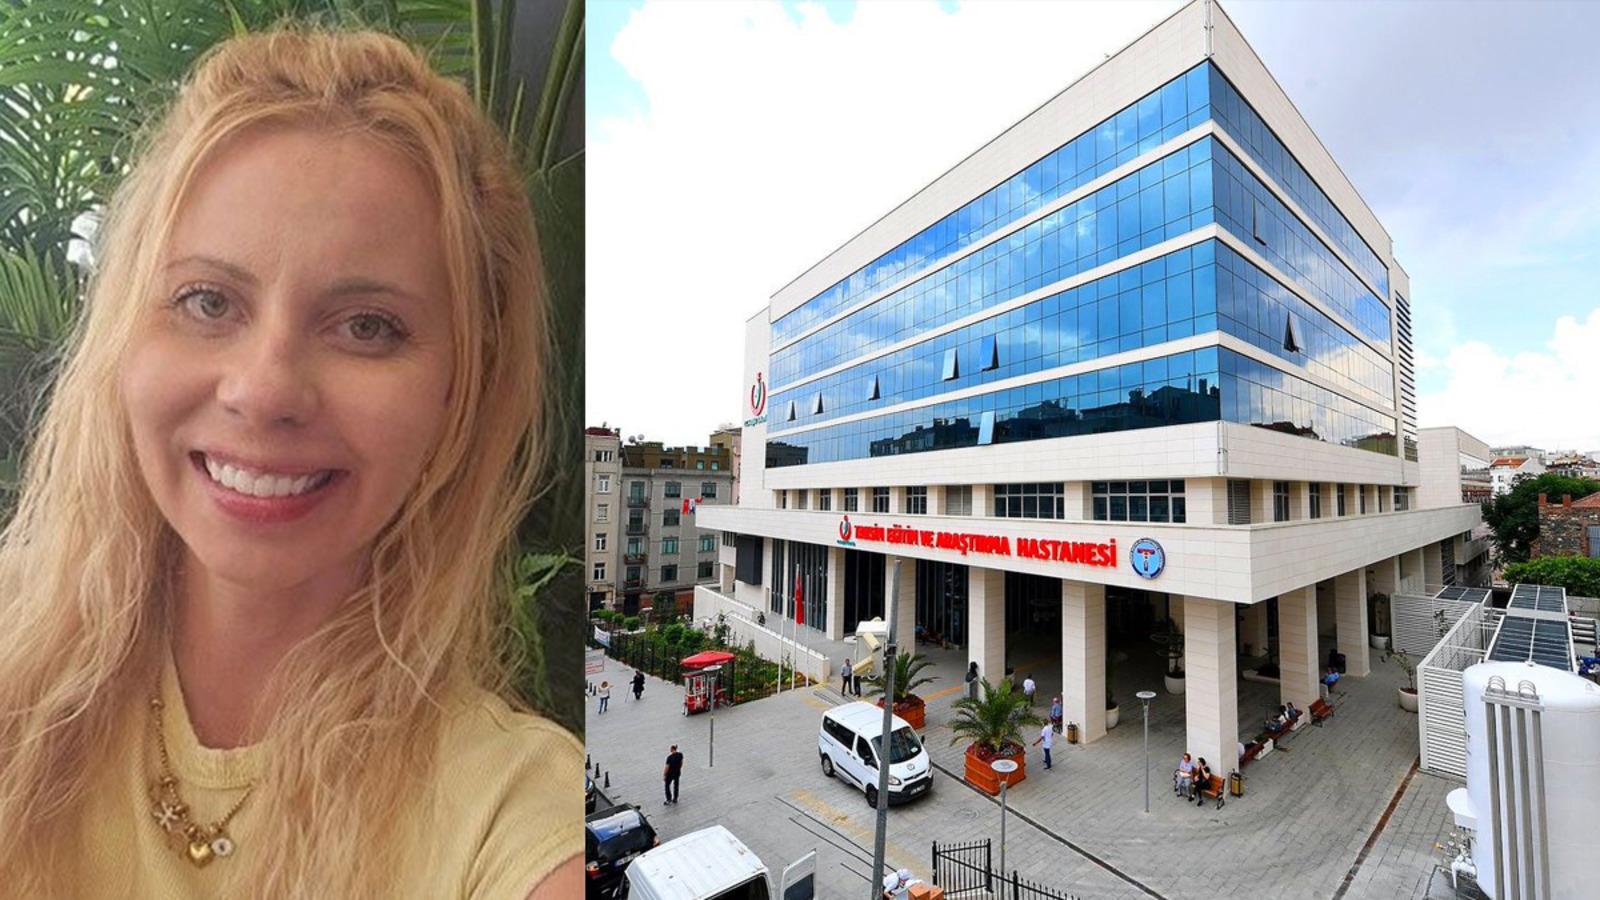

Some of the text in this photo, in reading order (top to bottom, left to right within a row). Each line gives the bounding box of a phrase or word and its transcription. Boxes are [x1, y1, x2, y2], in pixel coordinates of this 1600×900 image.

[919, 530, 934, 548] VE
[936, 531, 1011, 556] ARAŞTIRMA
[1016, 537, 1118, 568] HASTANESİ
